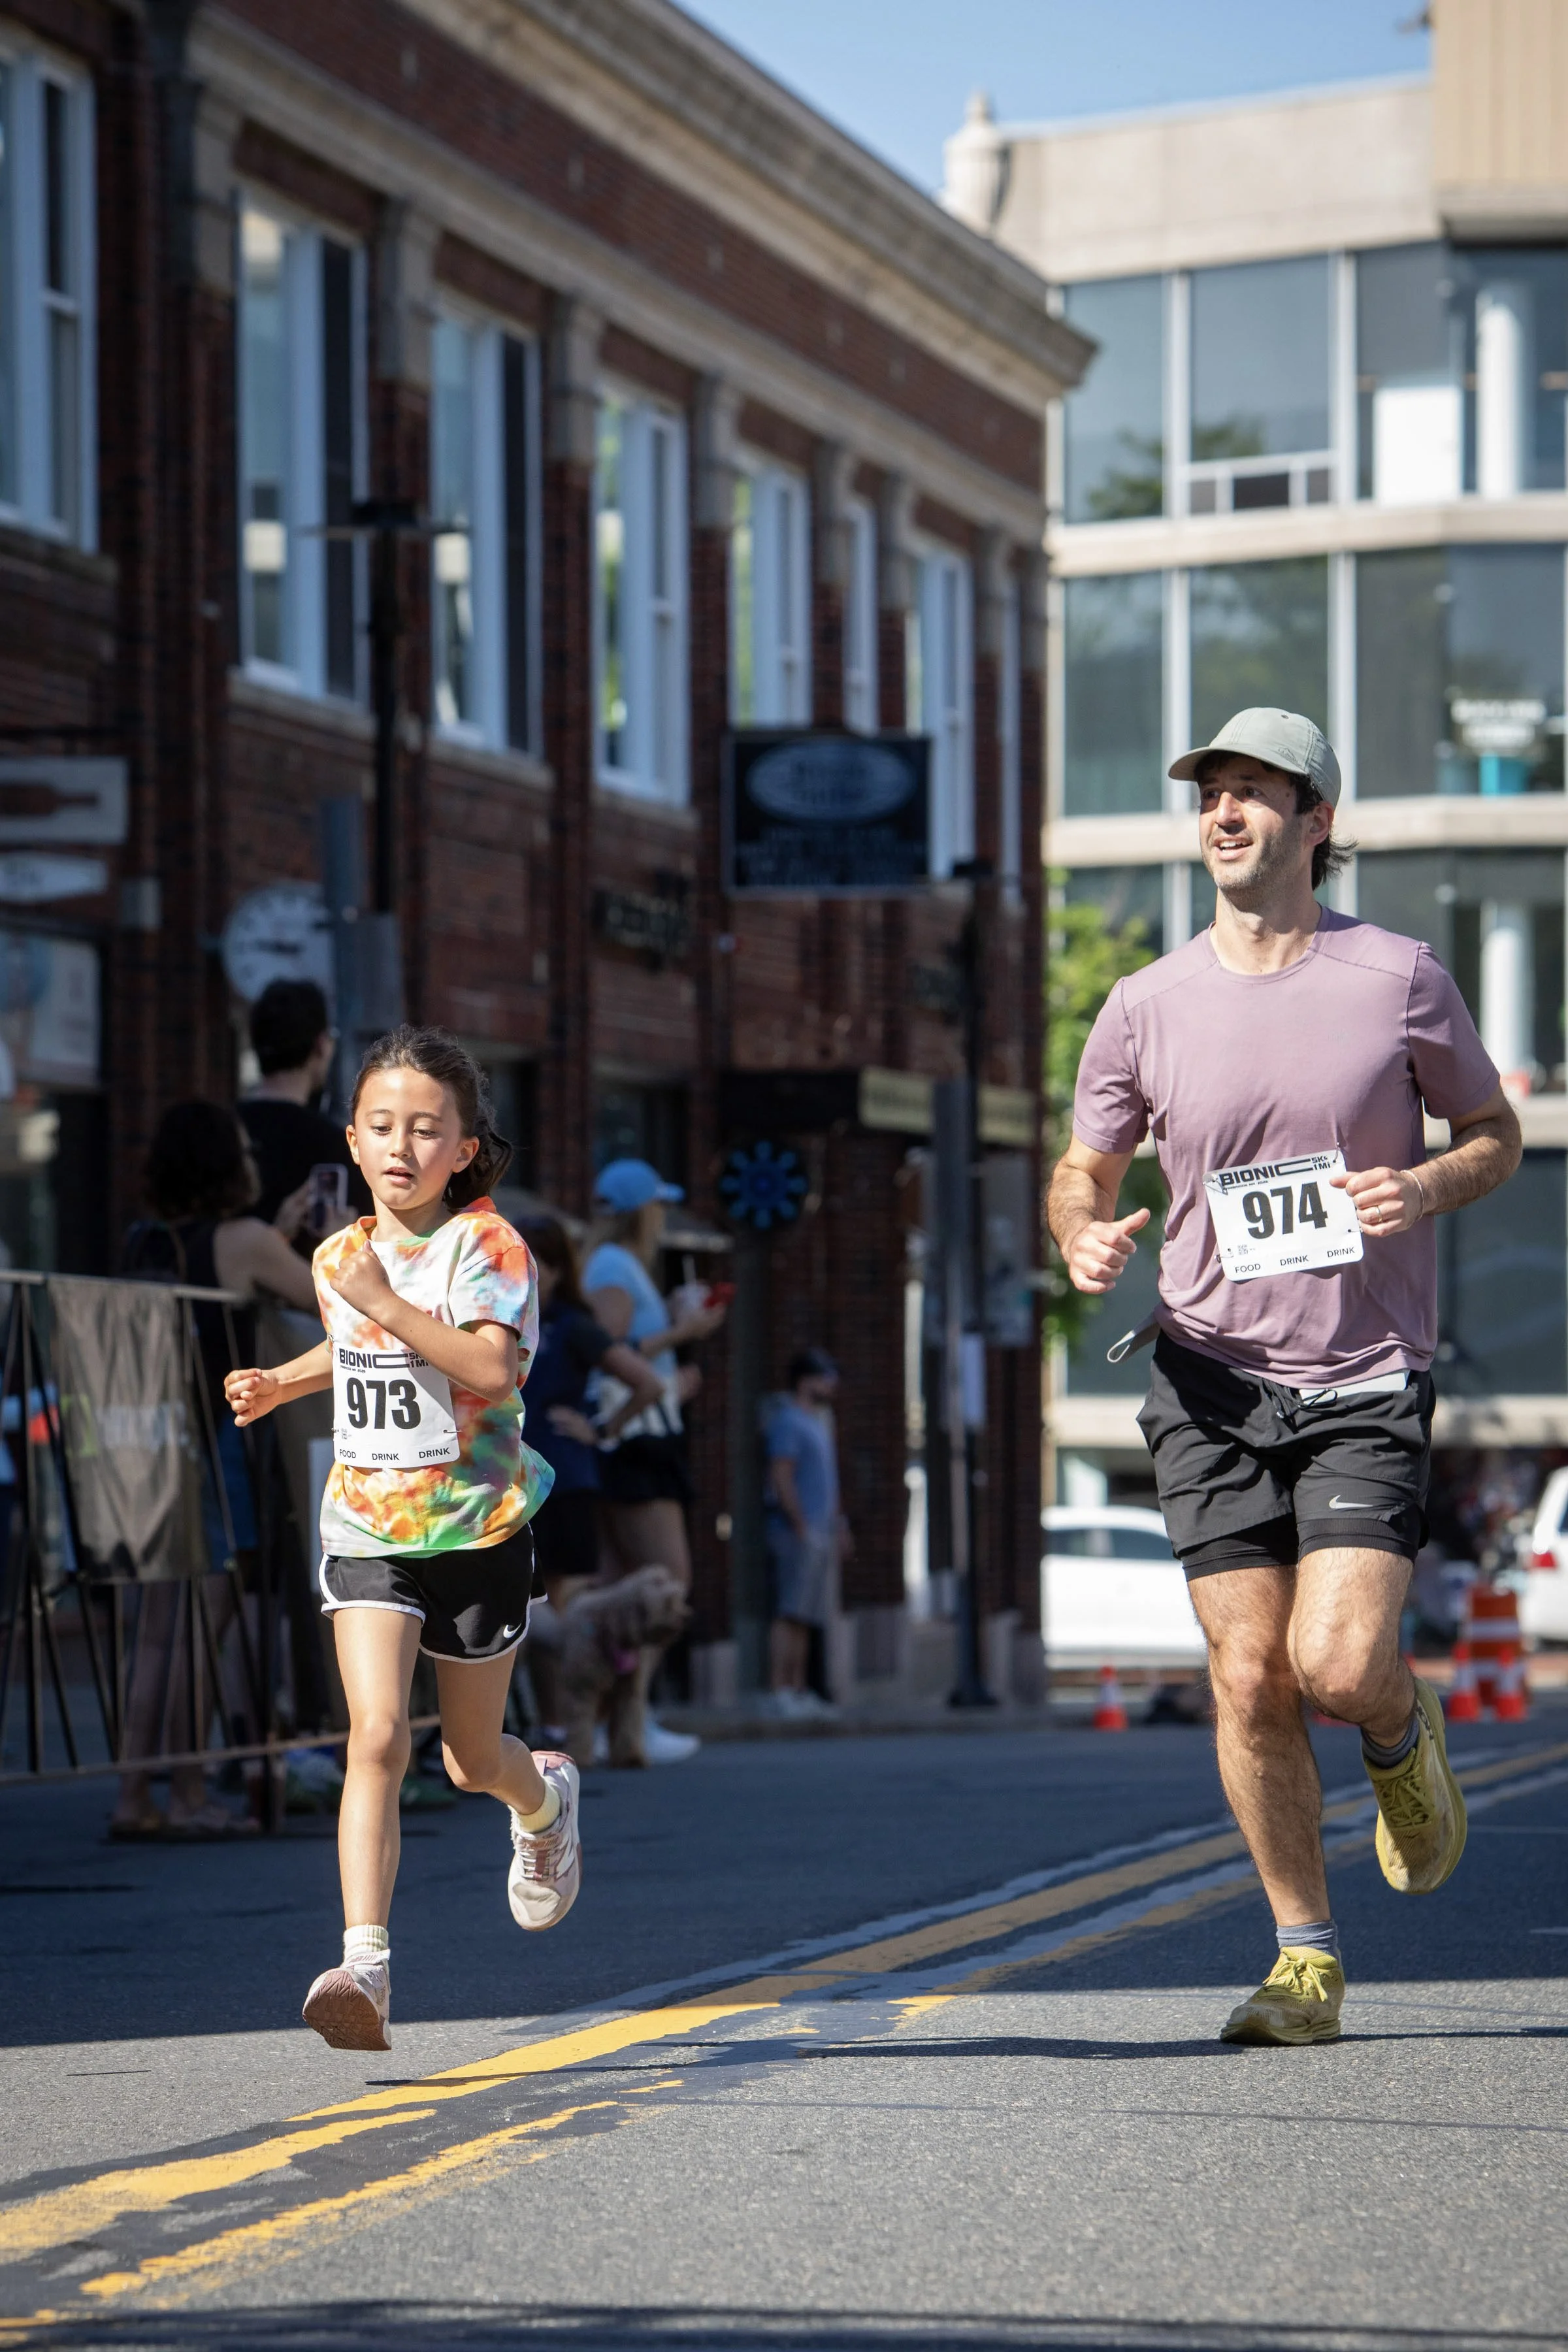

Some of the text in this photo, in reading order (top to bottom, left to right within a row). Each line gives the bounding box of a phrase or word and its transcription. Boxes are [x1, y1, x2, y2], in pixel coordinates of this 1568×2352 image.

[1219, 1158, 1313, 1186] BIONIC
[1242, 1181, 1328, 1239] 974
[1235, 1247, 1356, 1273] FOOD DRINK DRINK
[339, 1348, 410, 1369] BIONIC
[346, 1377, 421, 1429] 973
[339, 1448, 357, 1458] FOOD
[419, 1447, 451, 1459] DRINK
